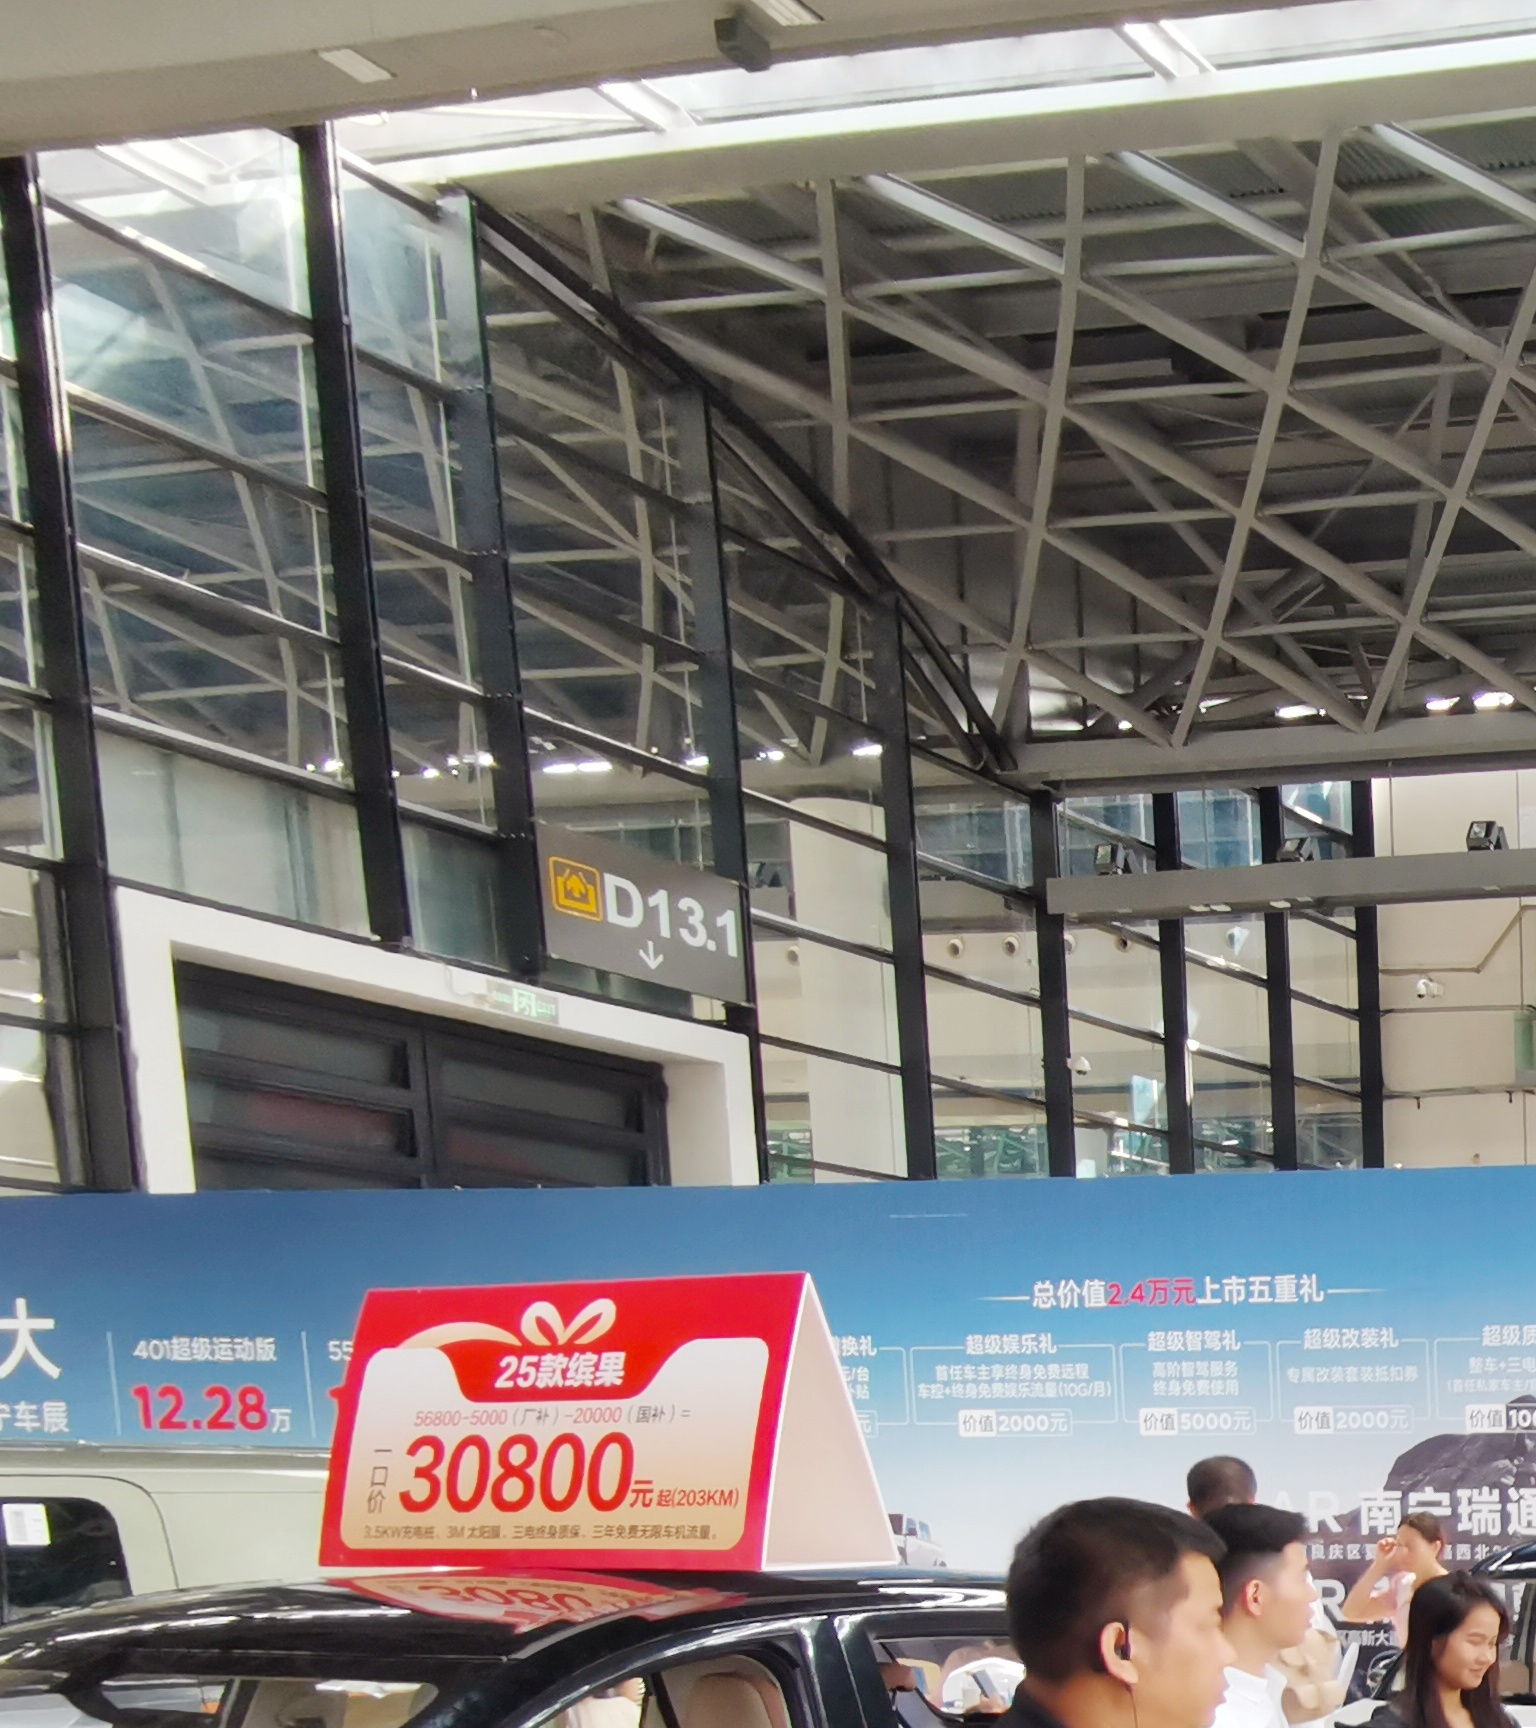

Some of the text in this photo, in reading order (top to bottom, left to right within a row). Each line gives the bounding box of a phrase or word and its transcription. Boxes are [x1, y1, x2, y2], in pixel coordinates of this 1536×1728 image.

[603, 872, 739, 958] D13.1
[133, 1336, 278, 1363] 401超级运动版
[494, 1350, 627, 1390] 25款缤果
